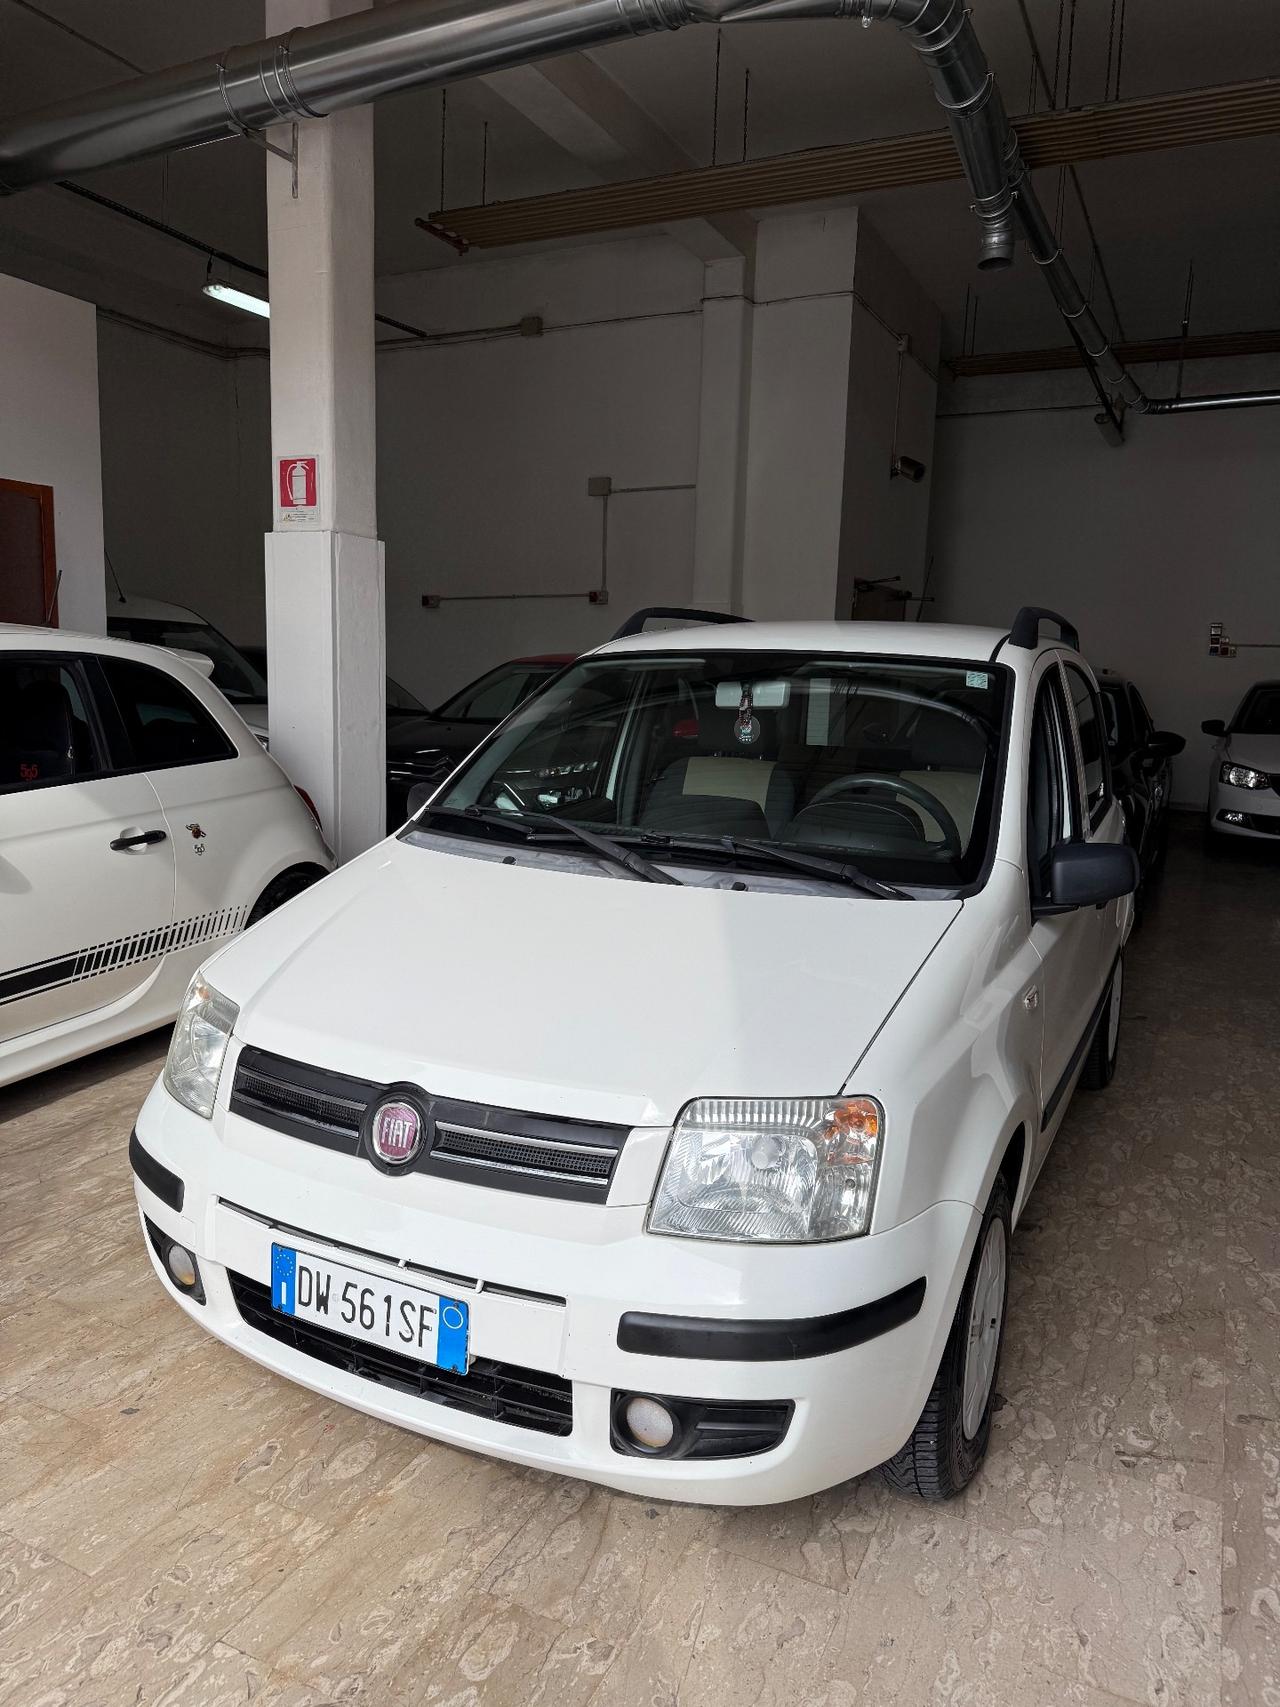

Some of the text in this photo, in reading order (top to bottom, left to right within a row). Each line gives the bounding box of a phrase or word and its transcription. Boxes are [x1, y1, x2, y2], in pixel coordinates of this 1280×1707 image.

[381, 1117, 413, 1148] FIAT
[298, 1265, 438, 1348] DW 561SF
